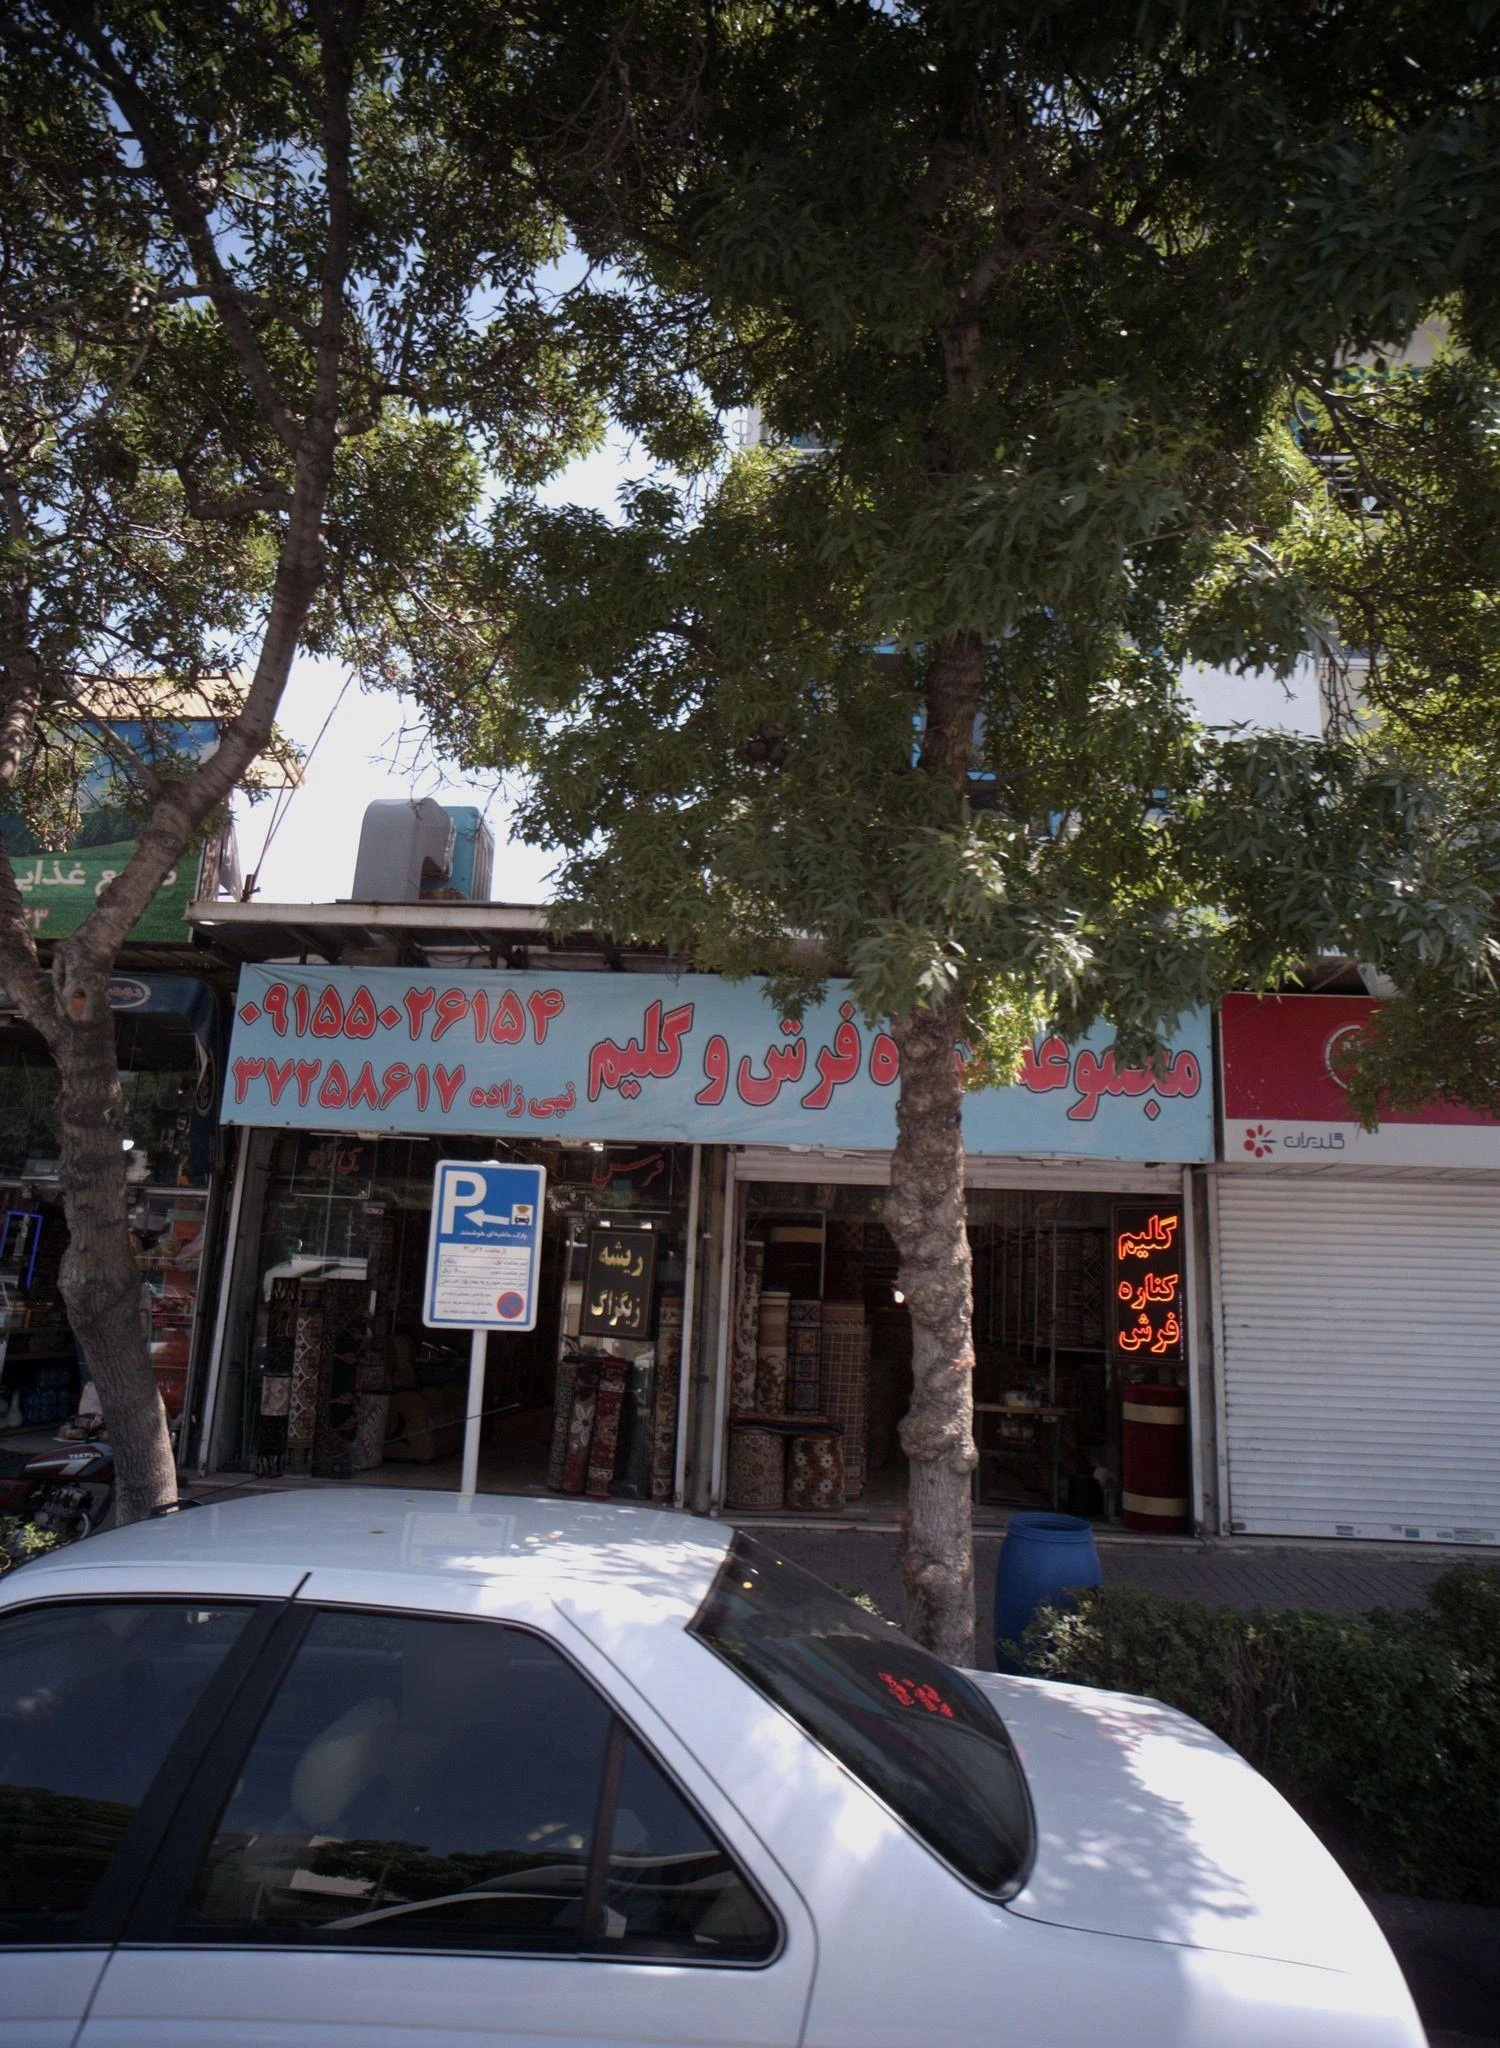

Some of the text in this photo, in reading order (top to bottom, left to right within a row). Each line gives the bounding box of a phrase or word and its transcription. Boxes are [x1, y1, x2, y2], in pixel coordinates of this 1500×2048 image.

[239, 982, 565, 1046] ۰۹۱۵۵۰۲۶۱۵۴
[587, 999, 695, 1102] گلیم
[695, 1034, 730, 1106] و
[736, 1000, 861, 1109] فرش
[232, 1056, 466, 1113] ۳۷۲۵۸۶۱۷
[469, 1078, 576, 1119] نبی زاده
[441, 1170, 487, 1234] P
[599, 1240, 644, 1277] ریشه
[1118, 1214, 1178, 1260] گلیم
[1118, 1272, 1179, 1310] کناره
[1118, 1311, 1180, 1353] فرش
